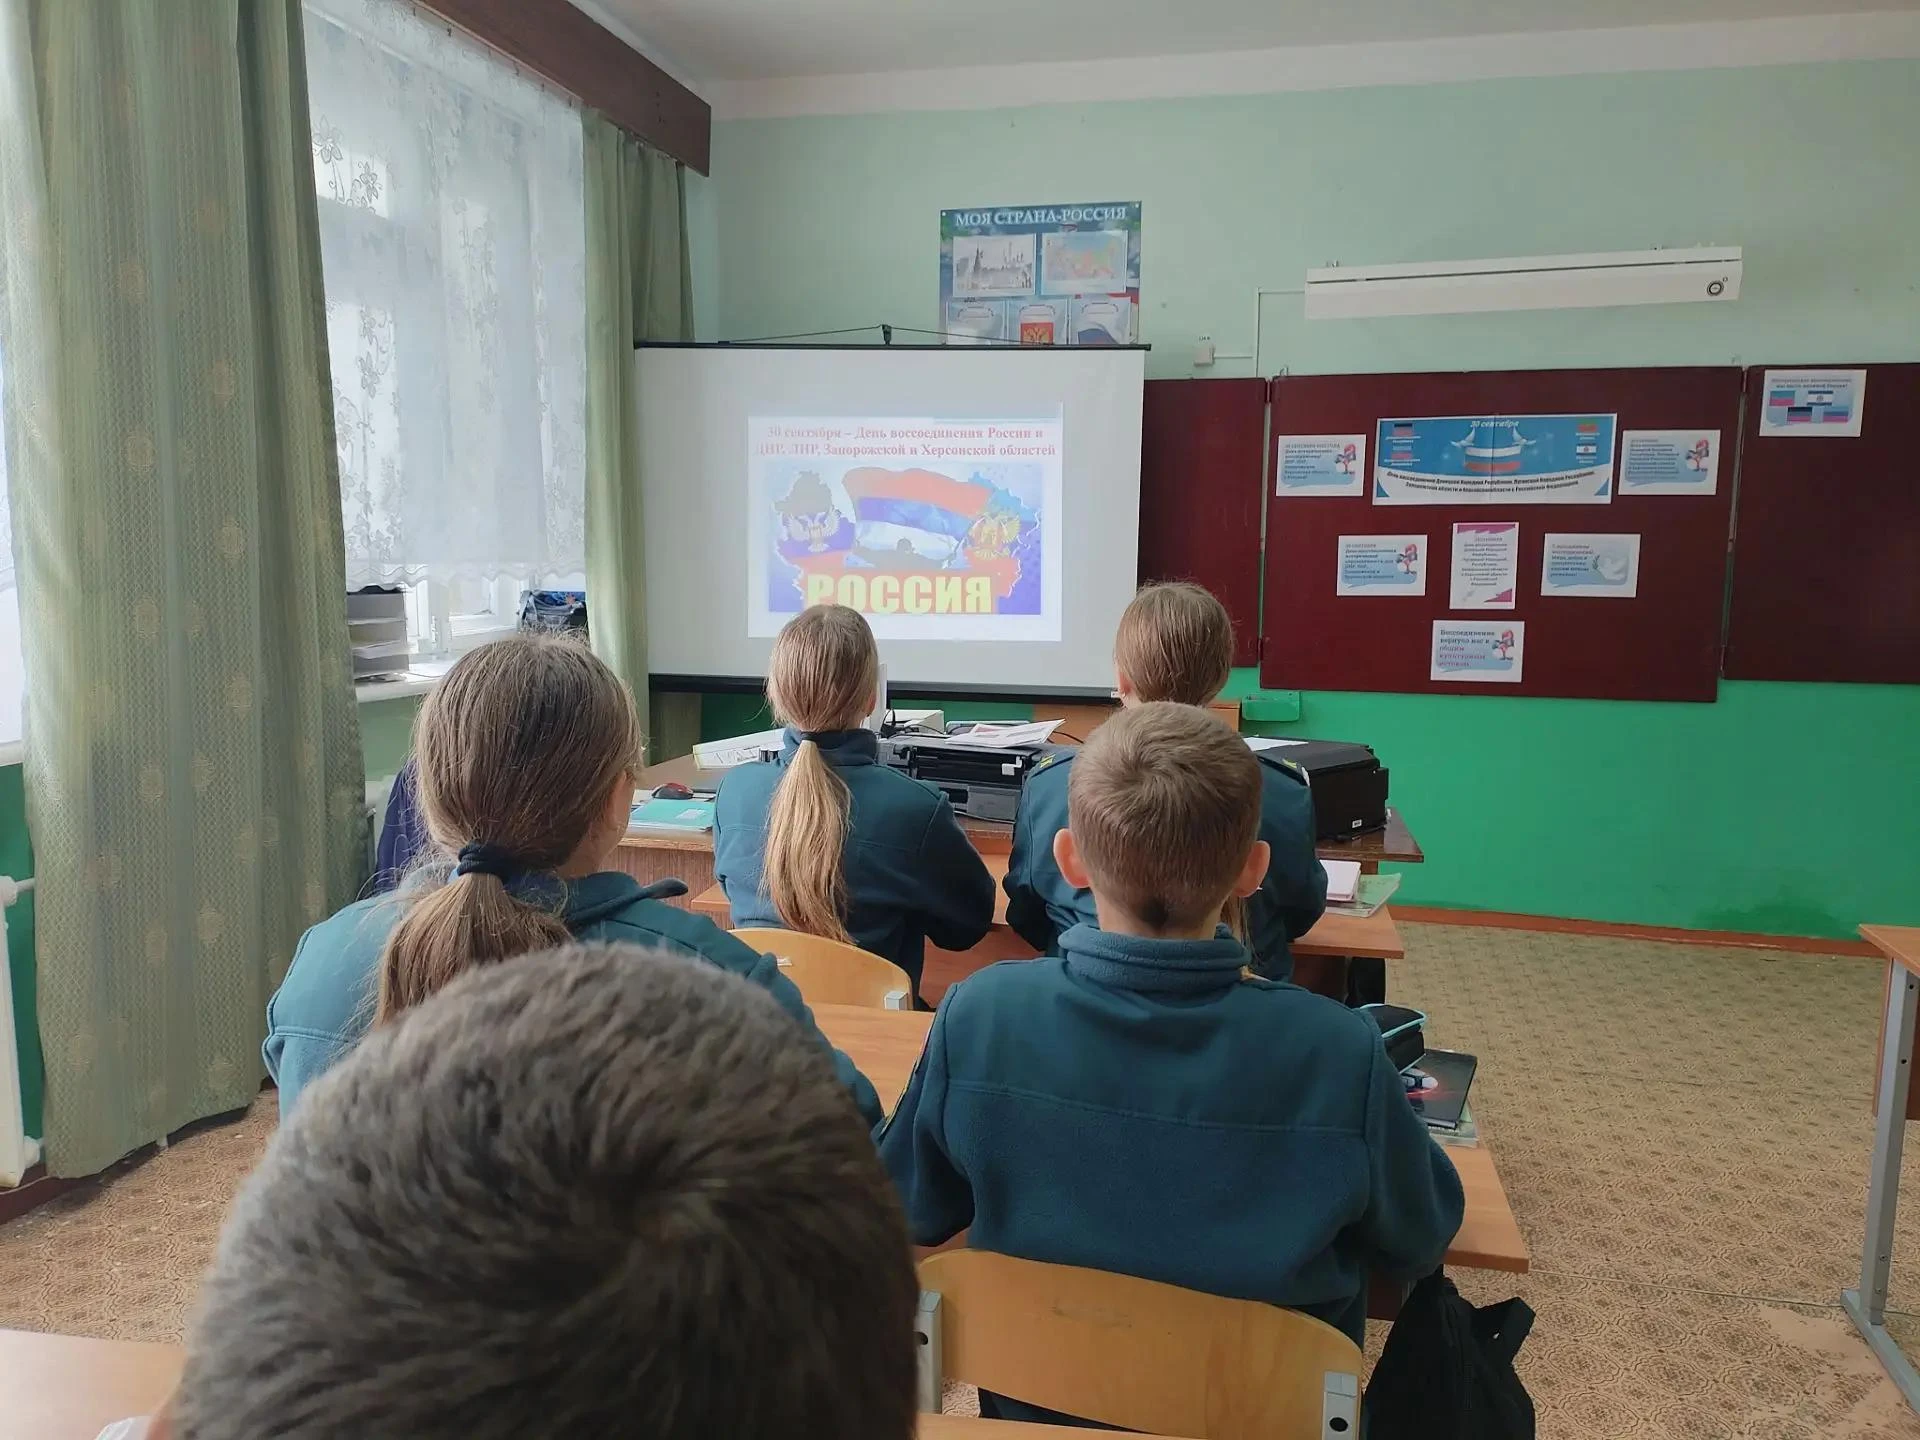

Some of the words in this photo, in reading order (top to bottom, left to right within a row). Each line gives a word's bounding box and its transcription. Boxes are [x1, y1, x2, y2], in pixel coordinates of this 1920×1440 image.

[955, 212, 992, 227] МОЯ
[769, 427, 781, 438] 30
[784, 427, 841, 441] сентября
[856, 427, 887, 440] День
[890, 427, 983, 441] воссоединения
[988, 427, 1032, 440] России
[1035, 430, 1044, 439] и
[823, 442, 906, 458] Запорожской
[909, 446, 917, 456] и
[920, 443, 996, 458] Херсонской
[1000, 443, 1056, 457] областей
[808, 574, 991, 614] РОССИЯ
